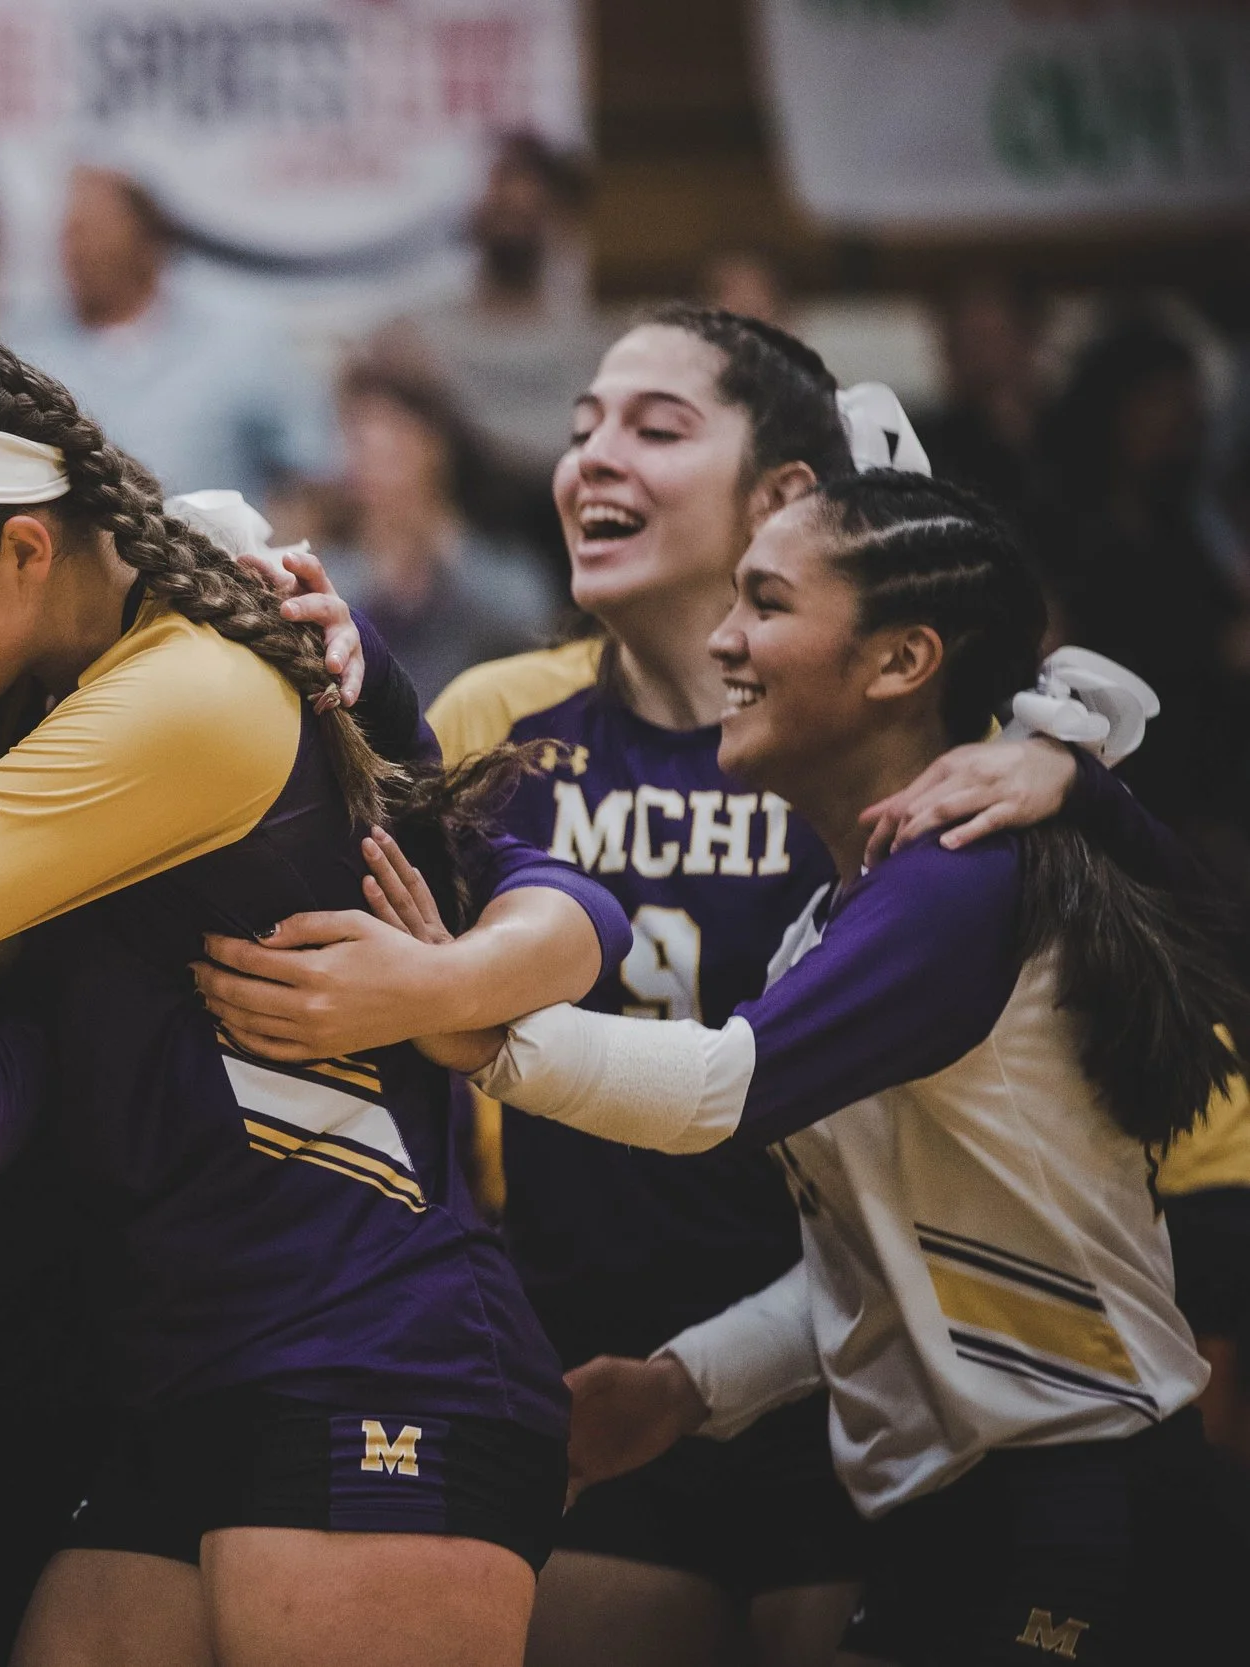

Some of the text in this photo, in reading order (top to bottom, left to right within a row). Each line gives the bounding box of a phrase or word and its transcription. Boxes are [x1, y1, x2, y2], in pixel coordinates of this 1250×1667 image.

[549, 780, 792, 878] MCHI
[620, 905, 702, 1020] 9
[361, 1420, 422, 1477] M
[1015, 1607, 1090, 1660] M
